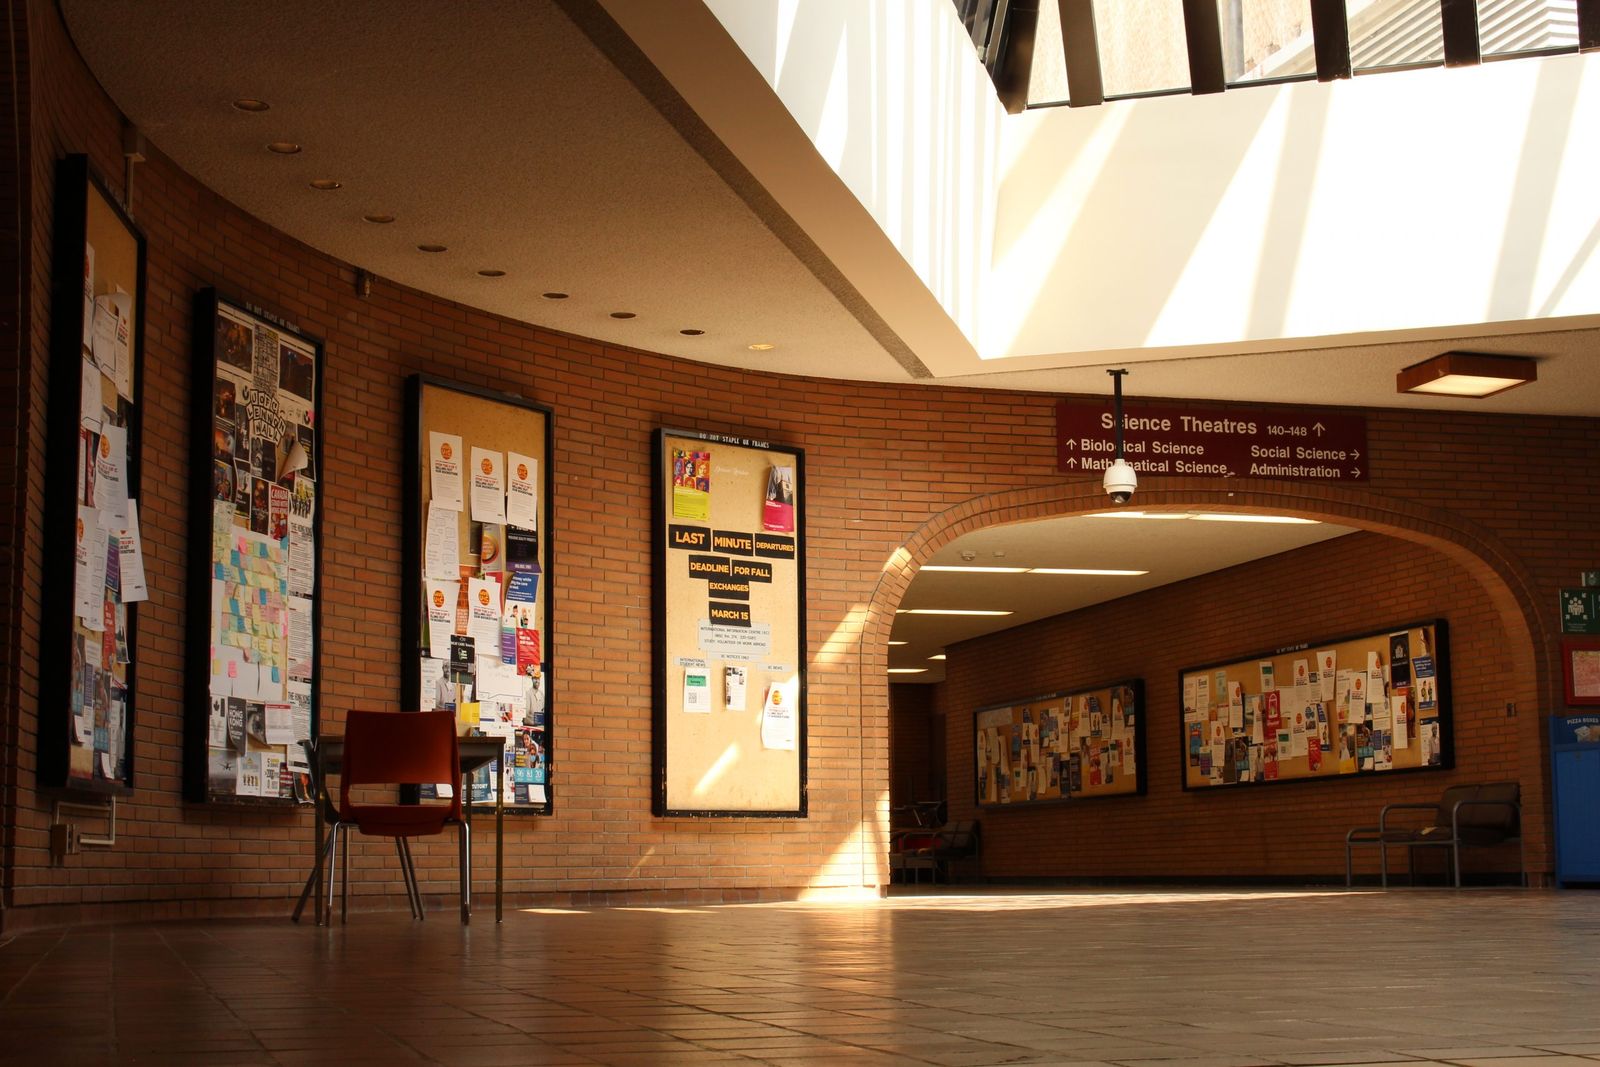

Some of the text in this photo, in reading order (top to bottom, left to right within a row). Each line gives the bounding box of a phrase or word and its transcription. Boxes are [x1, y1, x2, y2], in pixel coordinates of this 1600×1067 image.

[247, 406, 285, 434] LENNON
[1101, 413, 1171, 431] Sience
[1180, 416, 1257, 434] Theatres
[1081, 439, 1204, 455] Bioloical Science
[1251, 445, 1346, 460] Social Science
[1081, 457, 1227, 474] Mathmatical Science
[1250, 463, 1340, 478] Administration
[676, 531, 794, 552] LAST MINUTE DEPARTURES
[690, 562, 770, 577] DEADLINE FOR FALL
[710, 582, 749, 592] EXCHANGES
[712, 609, 748, 620] MARCH 15
[229, 709, 243, 718] HONG
[230, 718, 243, 727] KONG
